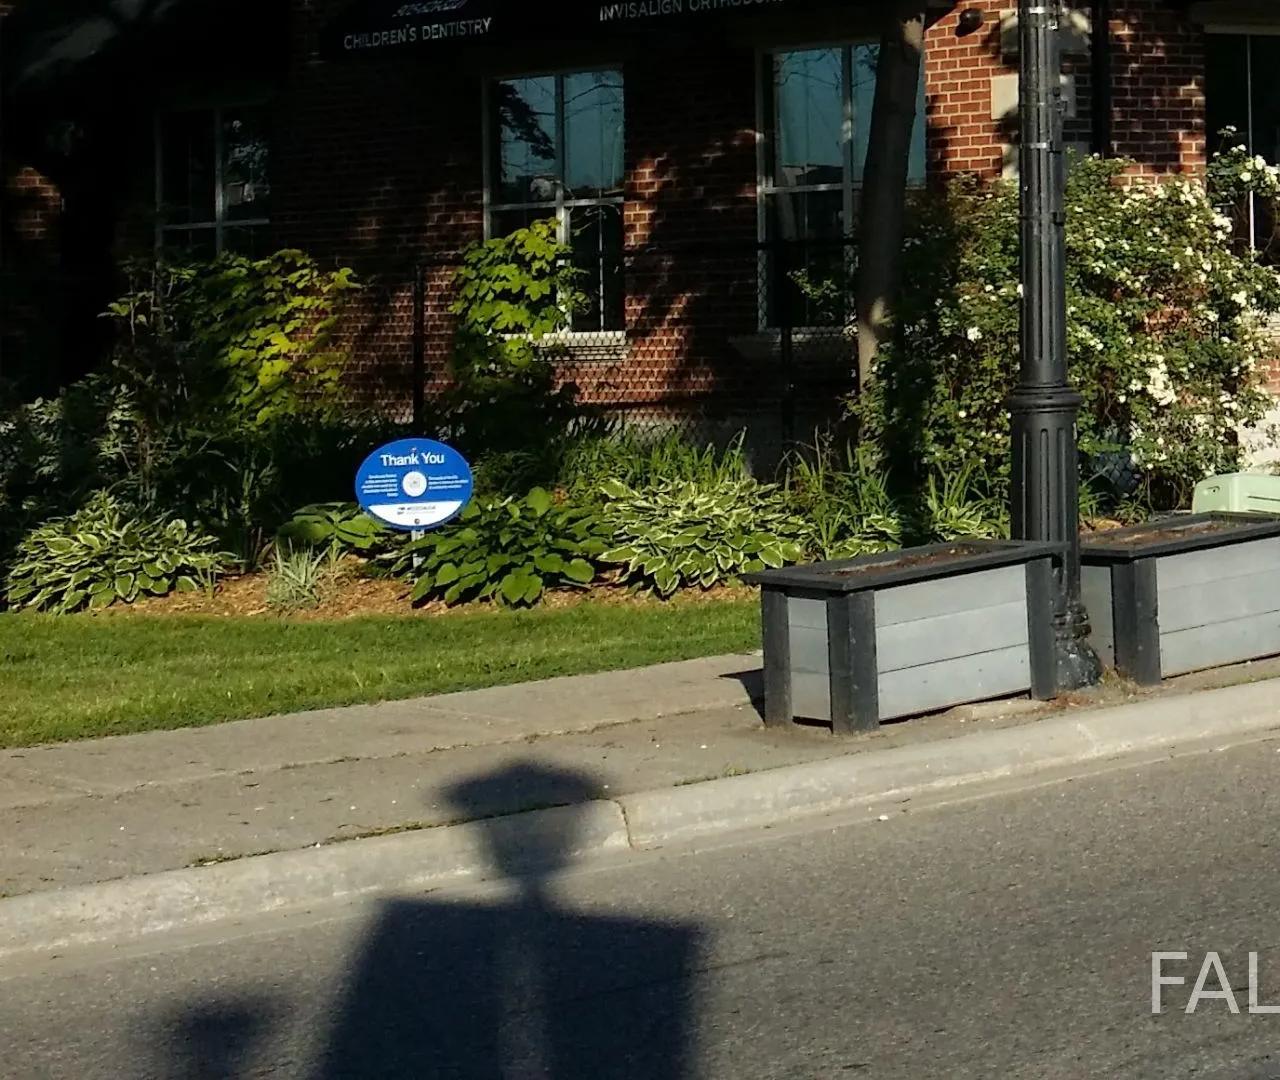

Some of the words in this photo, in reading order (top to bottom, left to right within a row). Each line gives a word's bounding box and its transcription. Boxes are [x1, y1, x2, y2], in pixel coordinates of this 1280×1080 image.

[344, 24, 417, 49] CHILDREN'S
[422, 17, 492, 40] DENTISTRY
[380, 453, 419, 467] Thank
[421, 452, 445, 464] You
